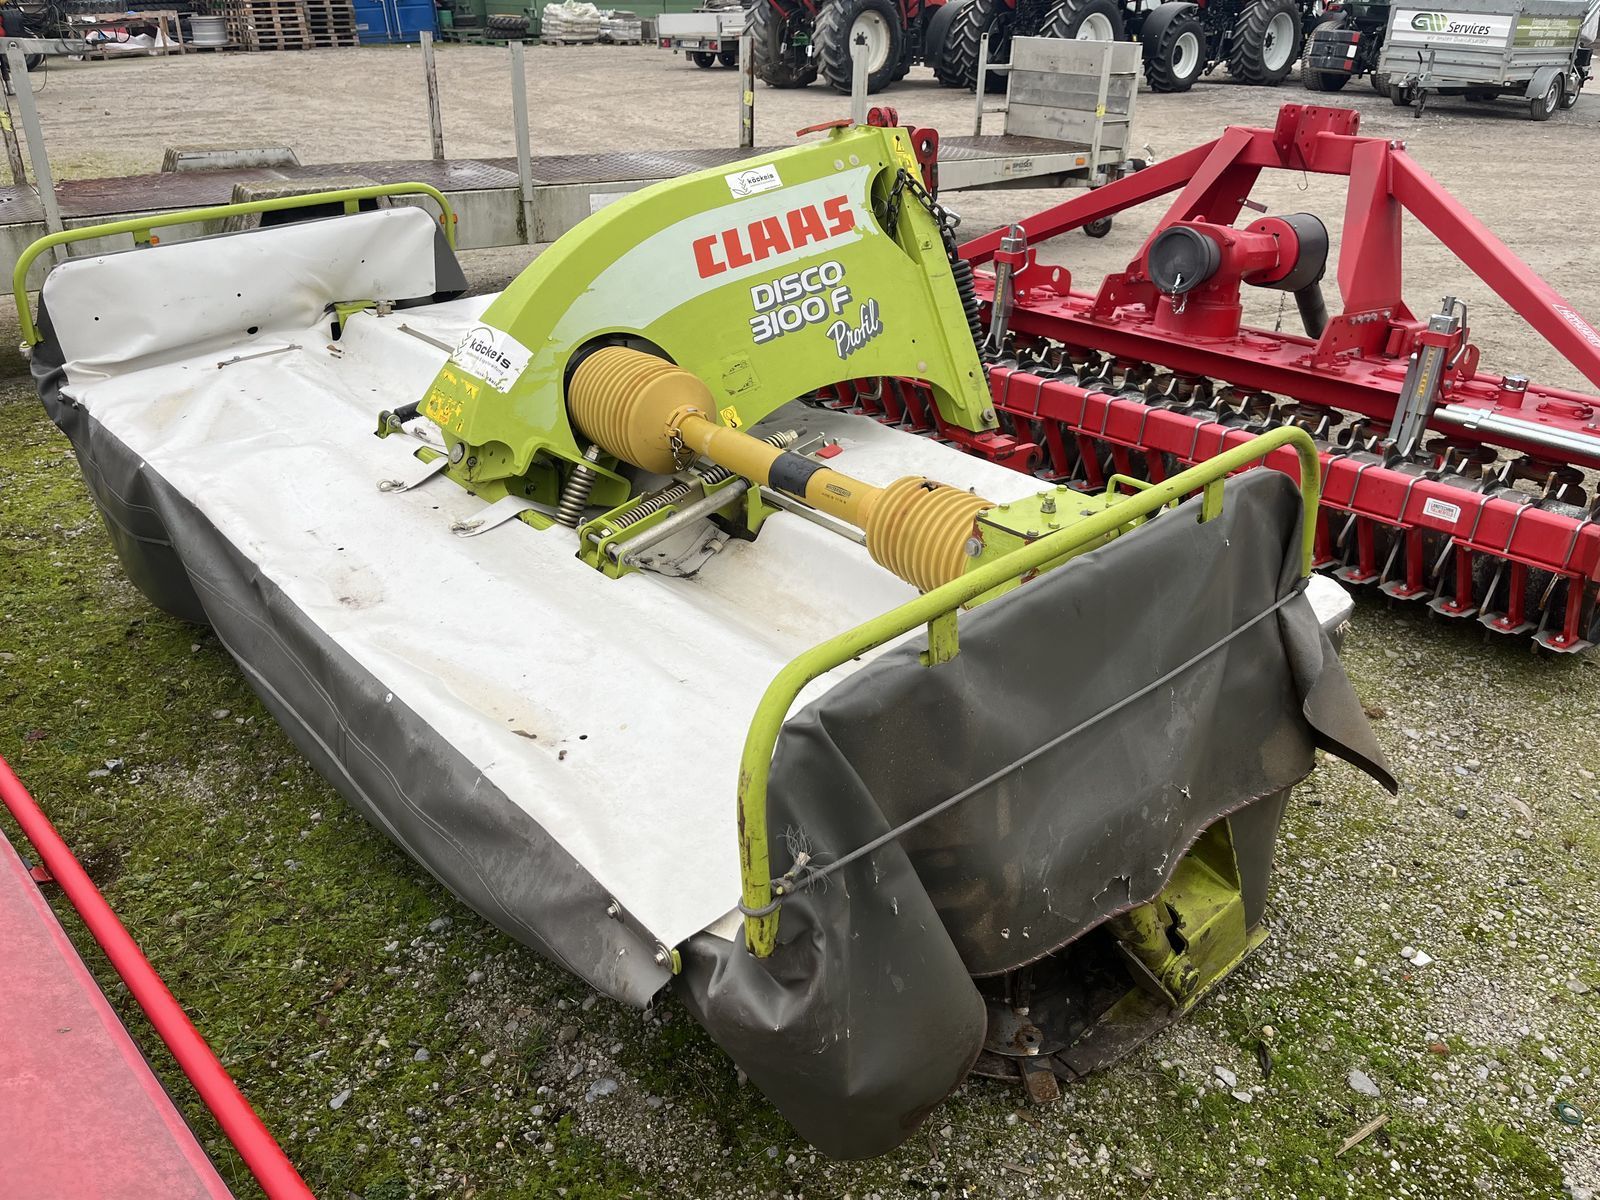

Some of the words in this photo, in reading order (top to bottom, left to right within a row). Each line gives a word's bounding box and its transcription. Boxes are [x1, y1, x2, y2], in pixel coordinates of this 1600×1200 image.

[1447, 21, 1491, 35] Services
[747, 173, 774, 184] köckeis
[692, 195, 856, 279] CLAAS
[750, 260, 845, 313] DISCO
[749, 296, 829, 344] 3100
[830, 286, 853, 315] F
[826, 298, 883, 360] Profil
[469, 338, 511, 369] köckeis
